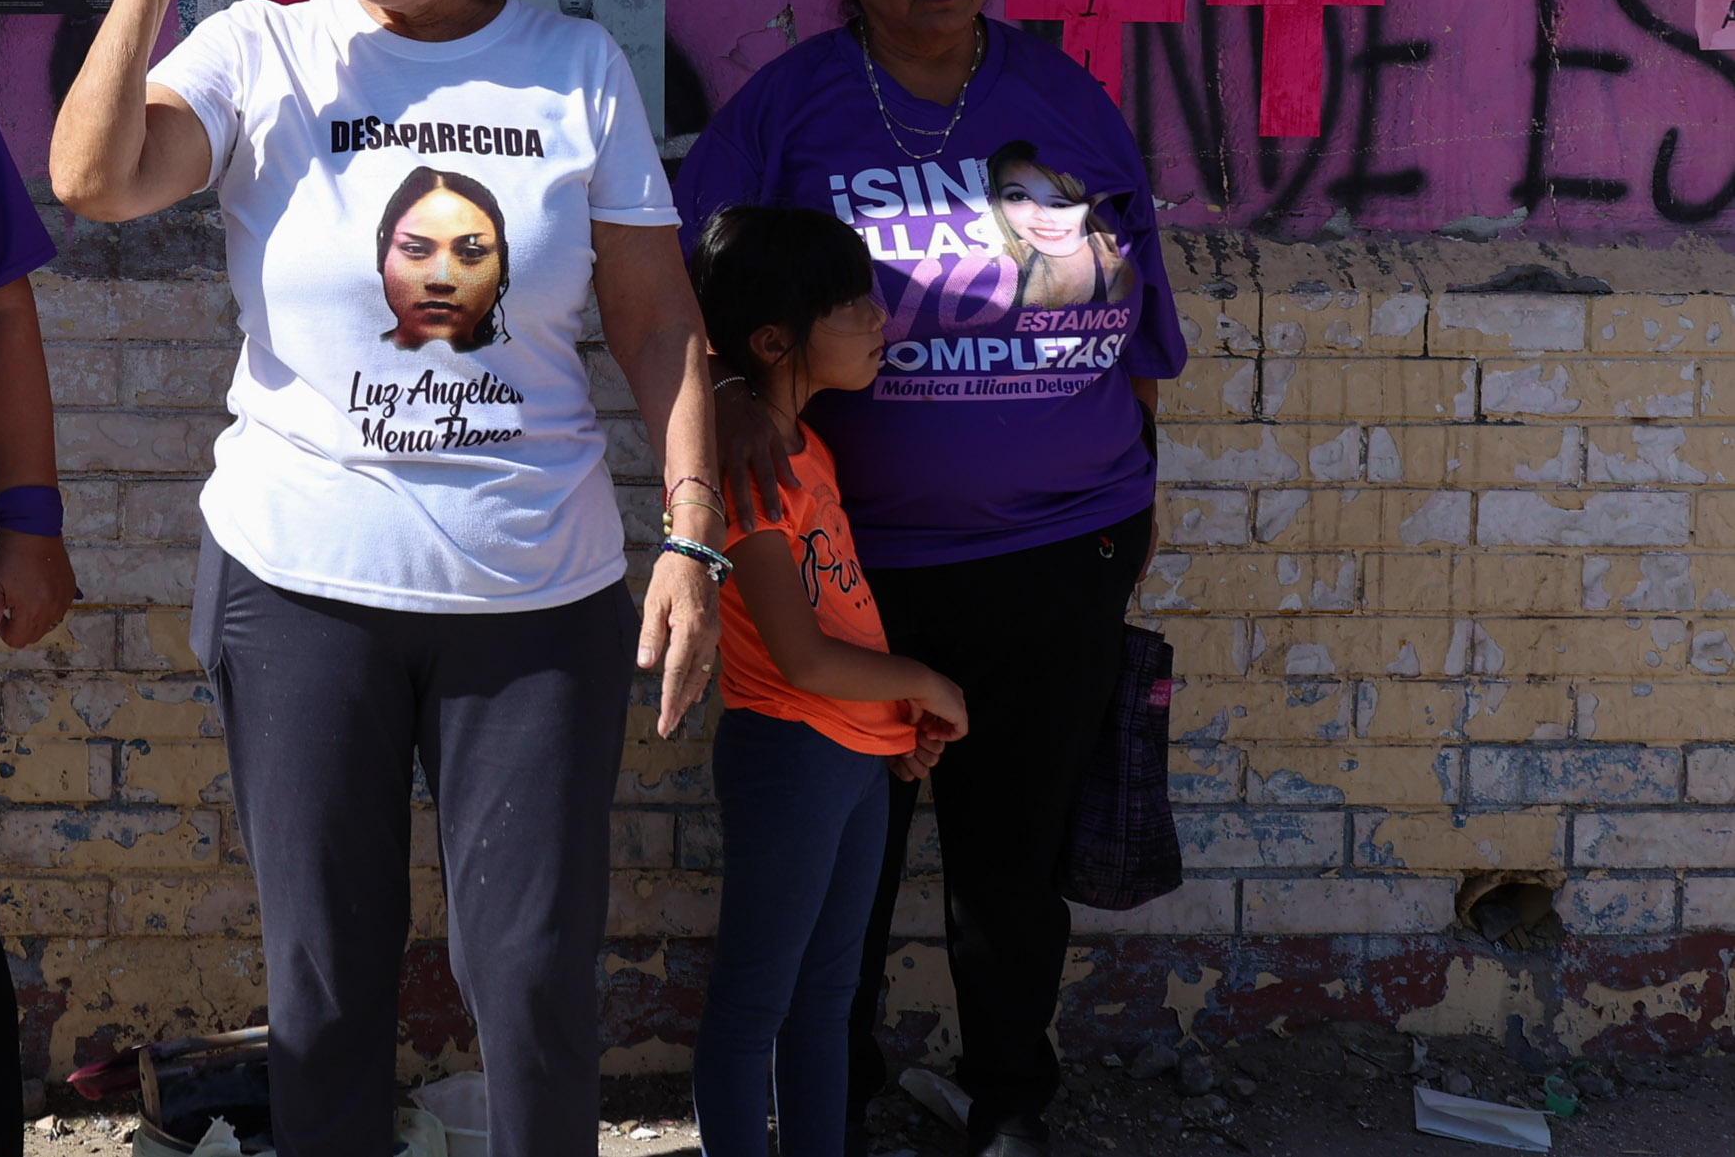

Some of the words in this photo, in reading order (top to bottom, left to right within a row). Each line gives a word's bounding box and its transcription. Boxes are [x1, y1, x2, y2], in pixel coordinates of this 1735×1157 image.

[331, 115, 545, 158] DESAPARECIDA
[829, 157, 992, 226] ¡SIN
[855, 222, 1006, 261] LLAS
[1015, 308, 1130, 333] ESTAMOS
[879, 334, 1125, 372] OMPLETAS!
[347, 370, 404, 418] Luz
[880, 378, 959, 398] Mónica
[963, 378, 1033, 396] Liliana
[362, 418, 434, 453] Mena
